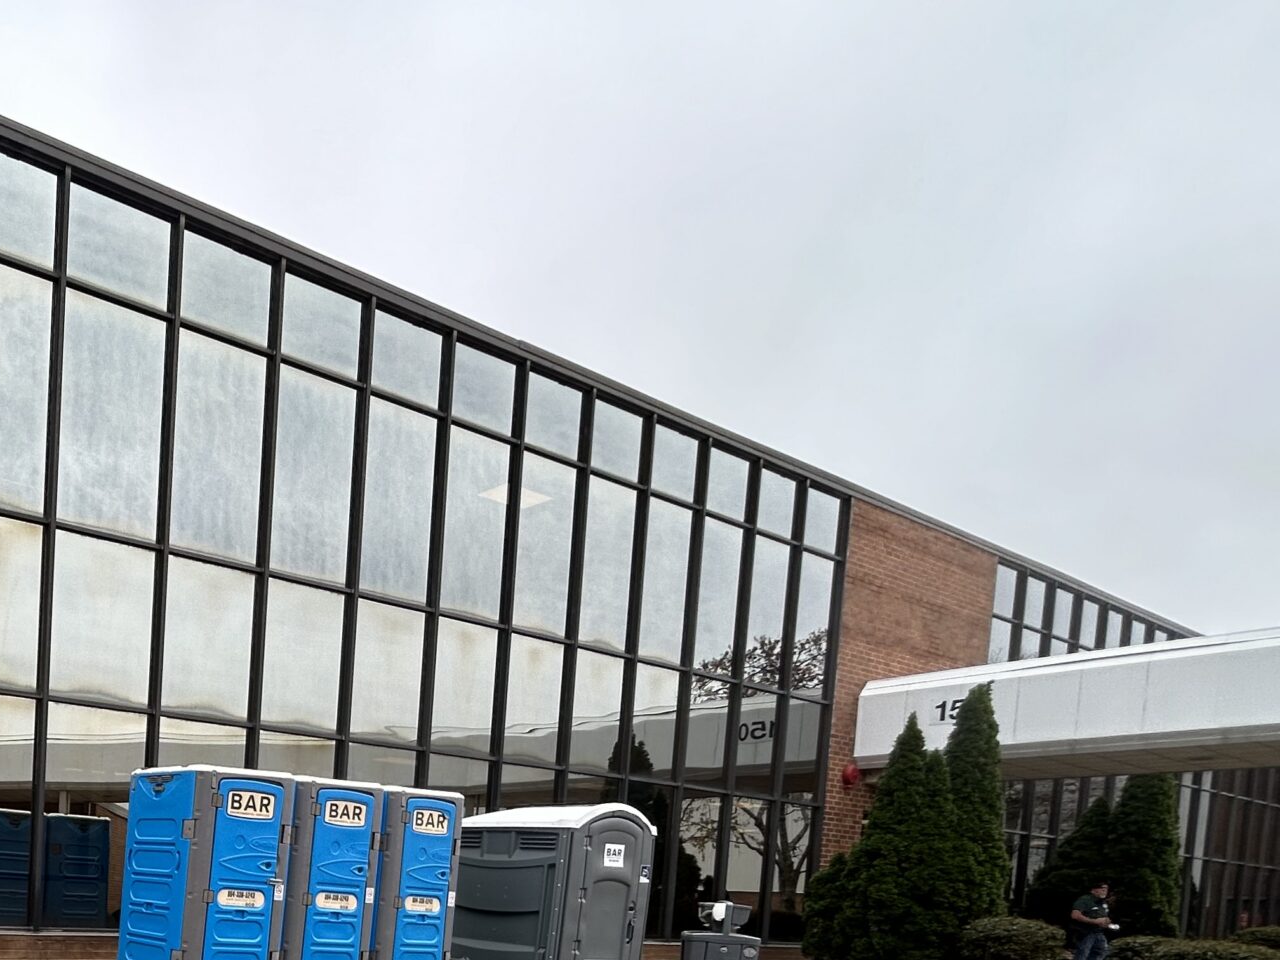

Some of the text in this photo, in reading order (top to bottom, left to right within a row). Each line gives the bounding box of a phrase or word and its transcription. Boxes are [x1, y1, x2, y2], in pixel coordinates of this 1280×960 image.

[935, 698, 966, 721] 15
[230, 792, 271, 813] BAR
[329, 803, 362, 821] BAR
[415, 811, 446, 829] BAR
[606, 848, 622, 857] BAR
